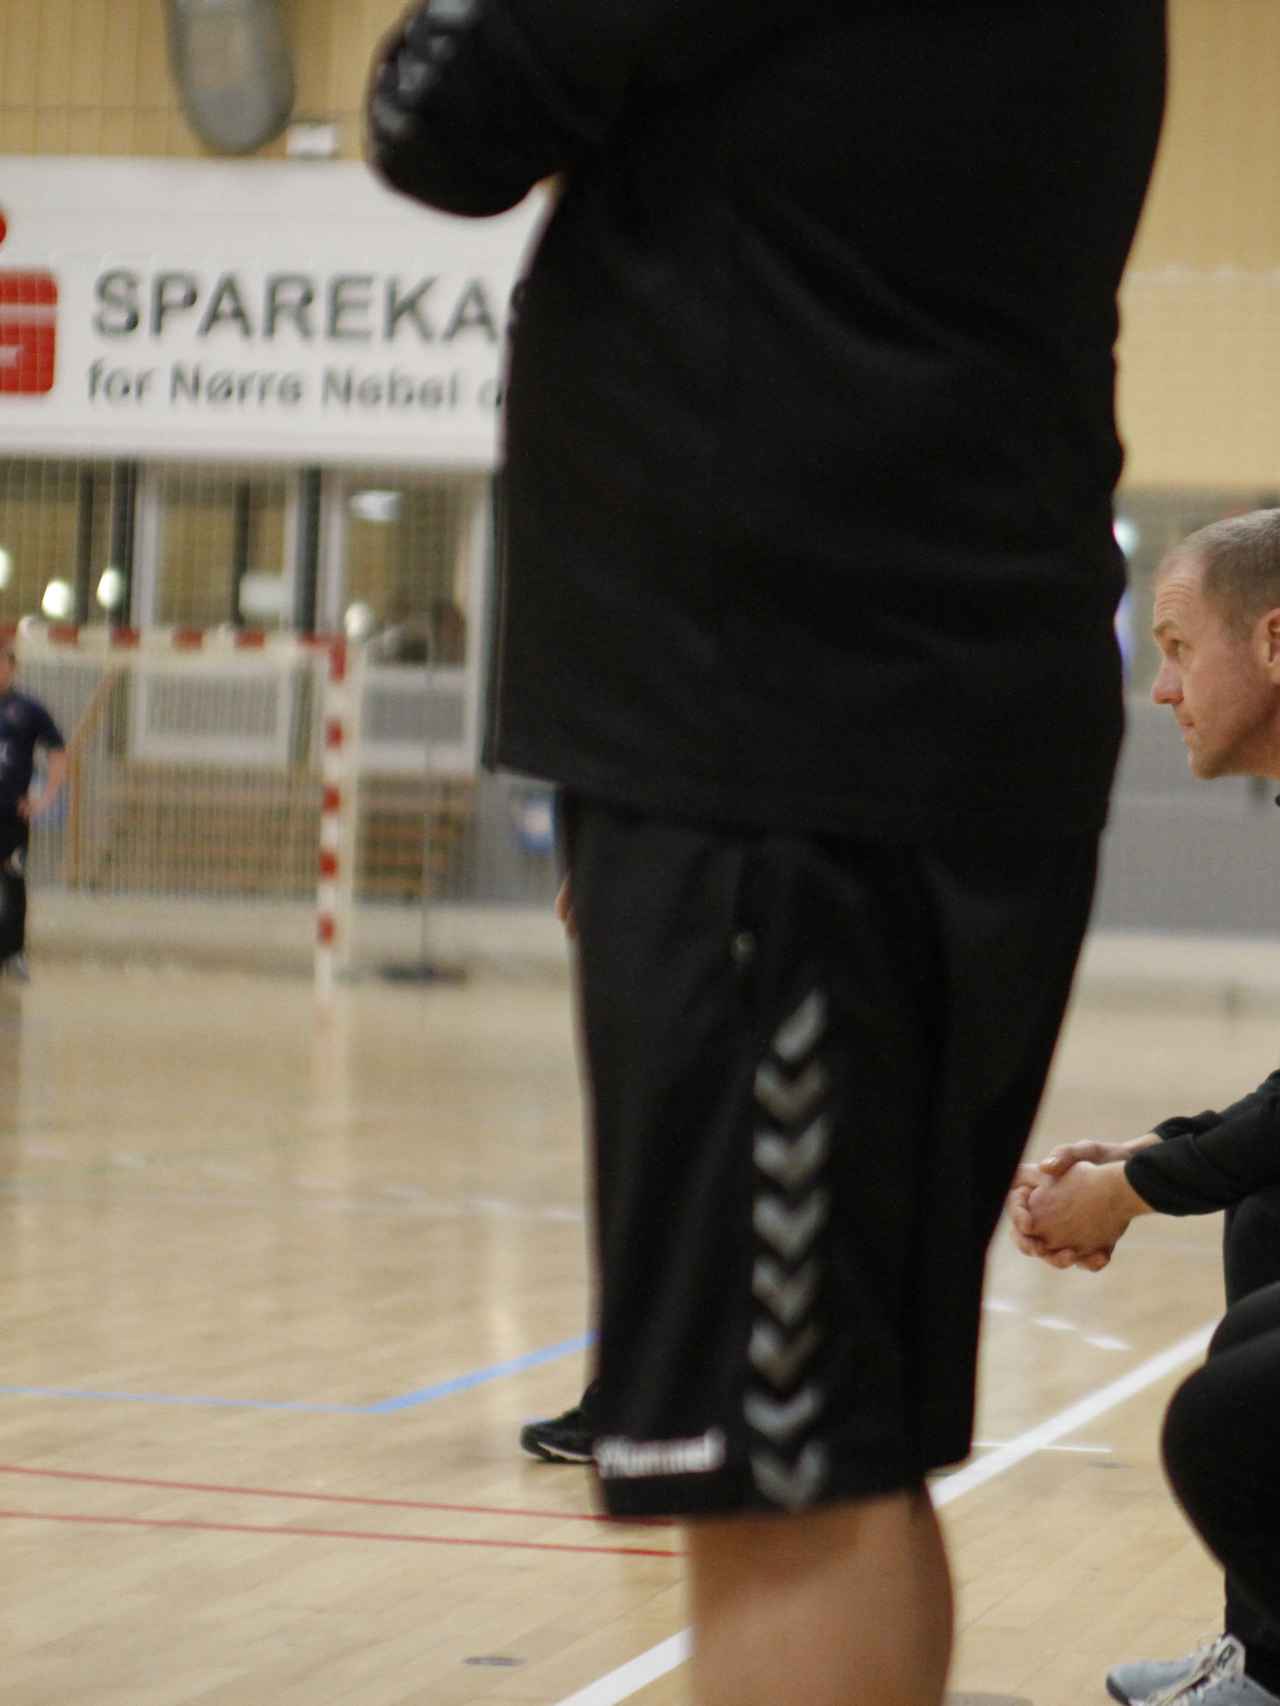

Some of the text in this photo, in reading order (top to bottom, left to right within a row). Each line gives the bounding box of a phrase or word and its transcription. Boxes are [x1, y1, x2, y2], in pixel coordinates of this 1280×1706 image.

[94, 270, 499, 340] SPAREKA
[88, 358, 153, 403] for
[169, 363, 303, 404] Nørre
[321, 366, 459, 406] Nebel
